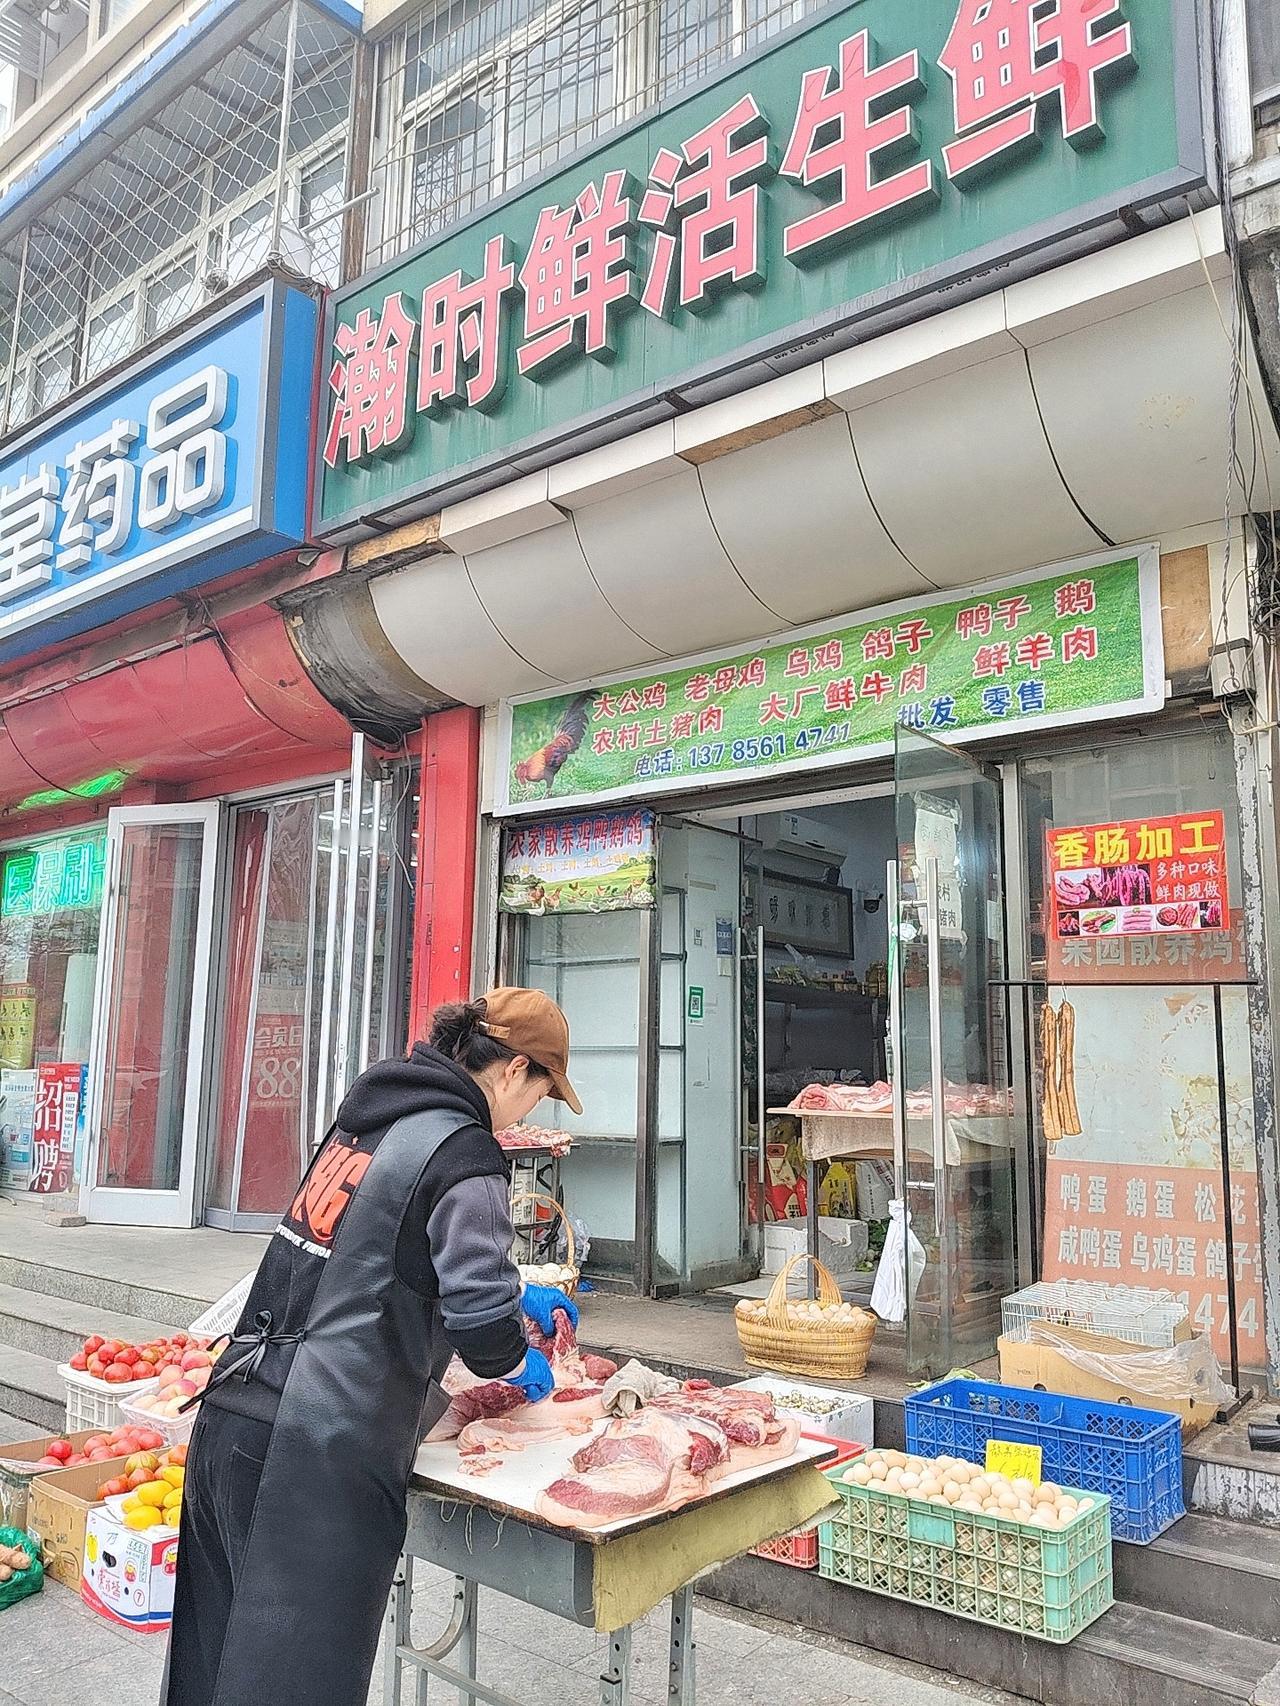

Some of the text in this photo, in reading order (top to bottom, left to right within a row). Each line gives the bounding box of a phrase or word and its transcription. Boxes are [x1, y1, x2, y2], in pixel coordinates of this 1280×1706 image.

[323, 0, 1135, 468] 瀚时鲜活生鲜
[593, 579, 1096, 721] 大公鸡 老母鸡 乌鸡 鸽子 鸭子 鹅
[592, 625, 1098, 755] 农村土猪肉 大厂鲜牛肉 鲜羊肉
[688, 742, 724, 768] 137
[732, 733, 786, 762] 8561
[795, 723, 850, 751] 4741
[897, 695, 957, 728] 批发
[982, 679, 1045, 716] 零售
[1055, 820, 1219, 867] 香肠加工
[1157, 858, 1218, 881] 多种口味
[1156, 880, 1221, 902] 鲜肉现做
[1061, 1173, 1259, 1226] 鸭蛋 鹅蛋 松花
[1058, 1226, 1122, 1270] 咸鸭蛋
[1130, 1231, 1197, 1277] 乌鸡蛋
